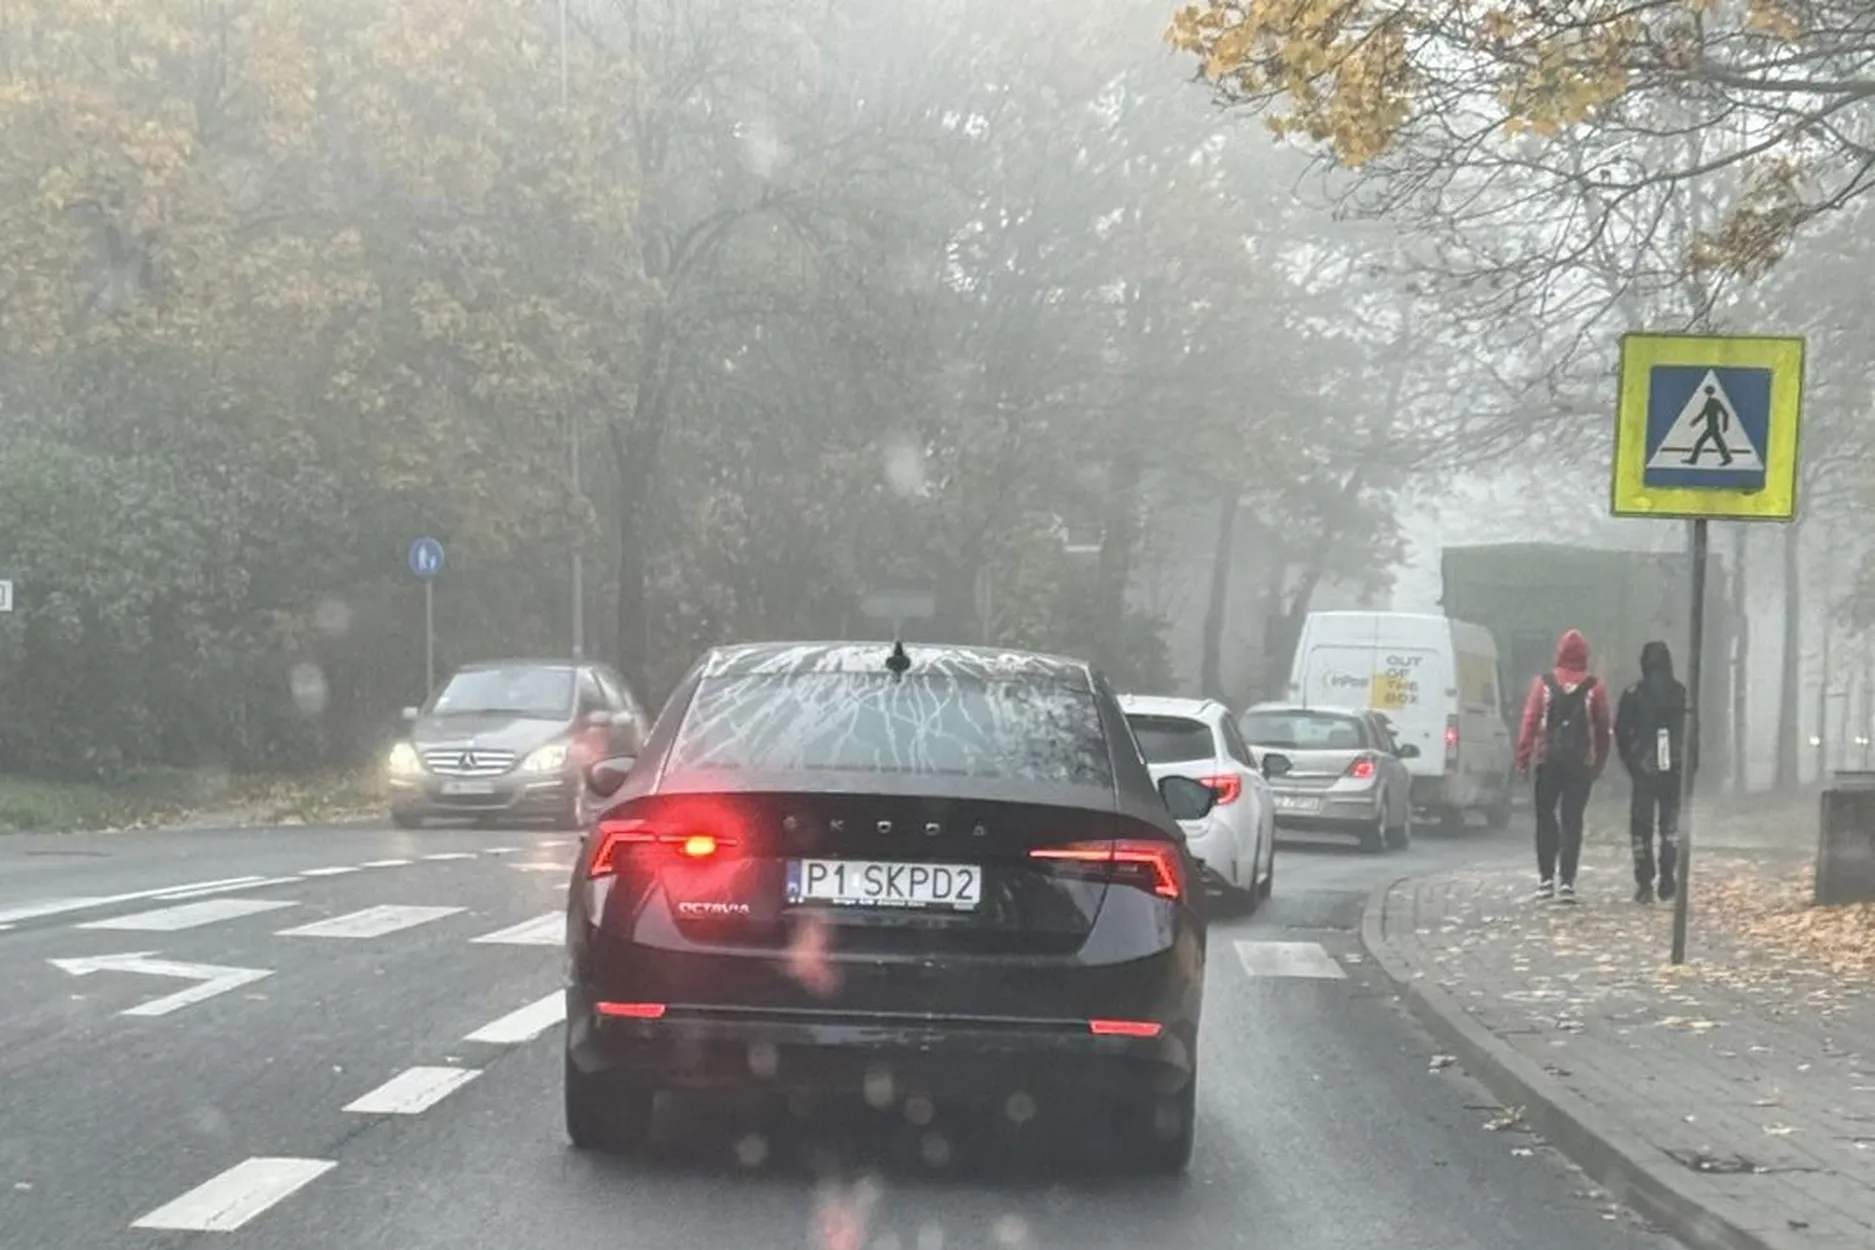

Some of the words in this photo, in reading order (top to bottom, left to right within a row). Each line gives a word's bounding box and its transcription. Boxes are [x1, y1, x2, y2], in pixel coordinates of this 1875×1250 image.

[1386, 655, 1422, 667] OUT
[1386, 667, 1410, 679] OF
[1384, 692, 1418, 704] BOX
[807, 863, 845, 895] P1
[864, 865, 974, 900] SKPD2
[678, 902, 750, 914] OCTAVIA
